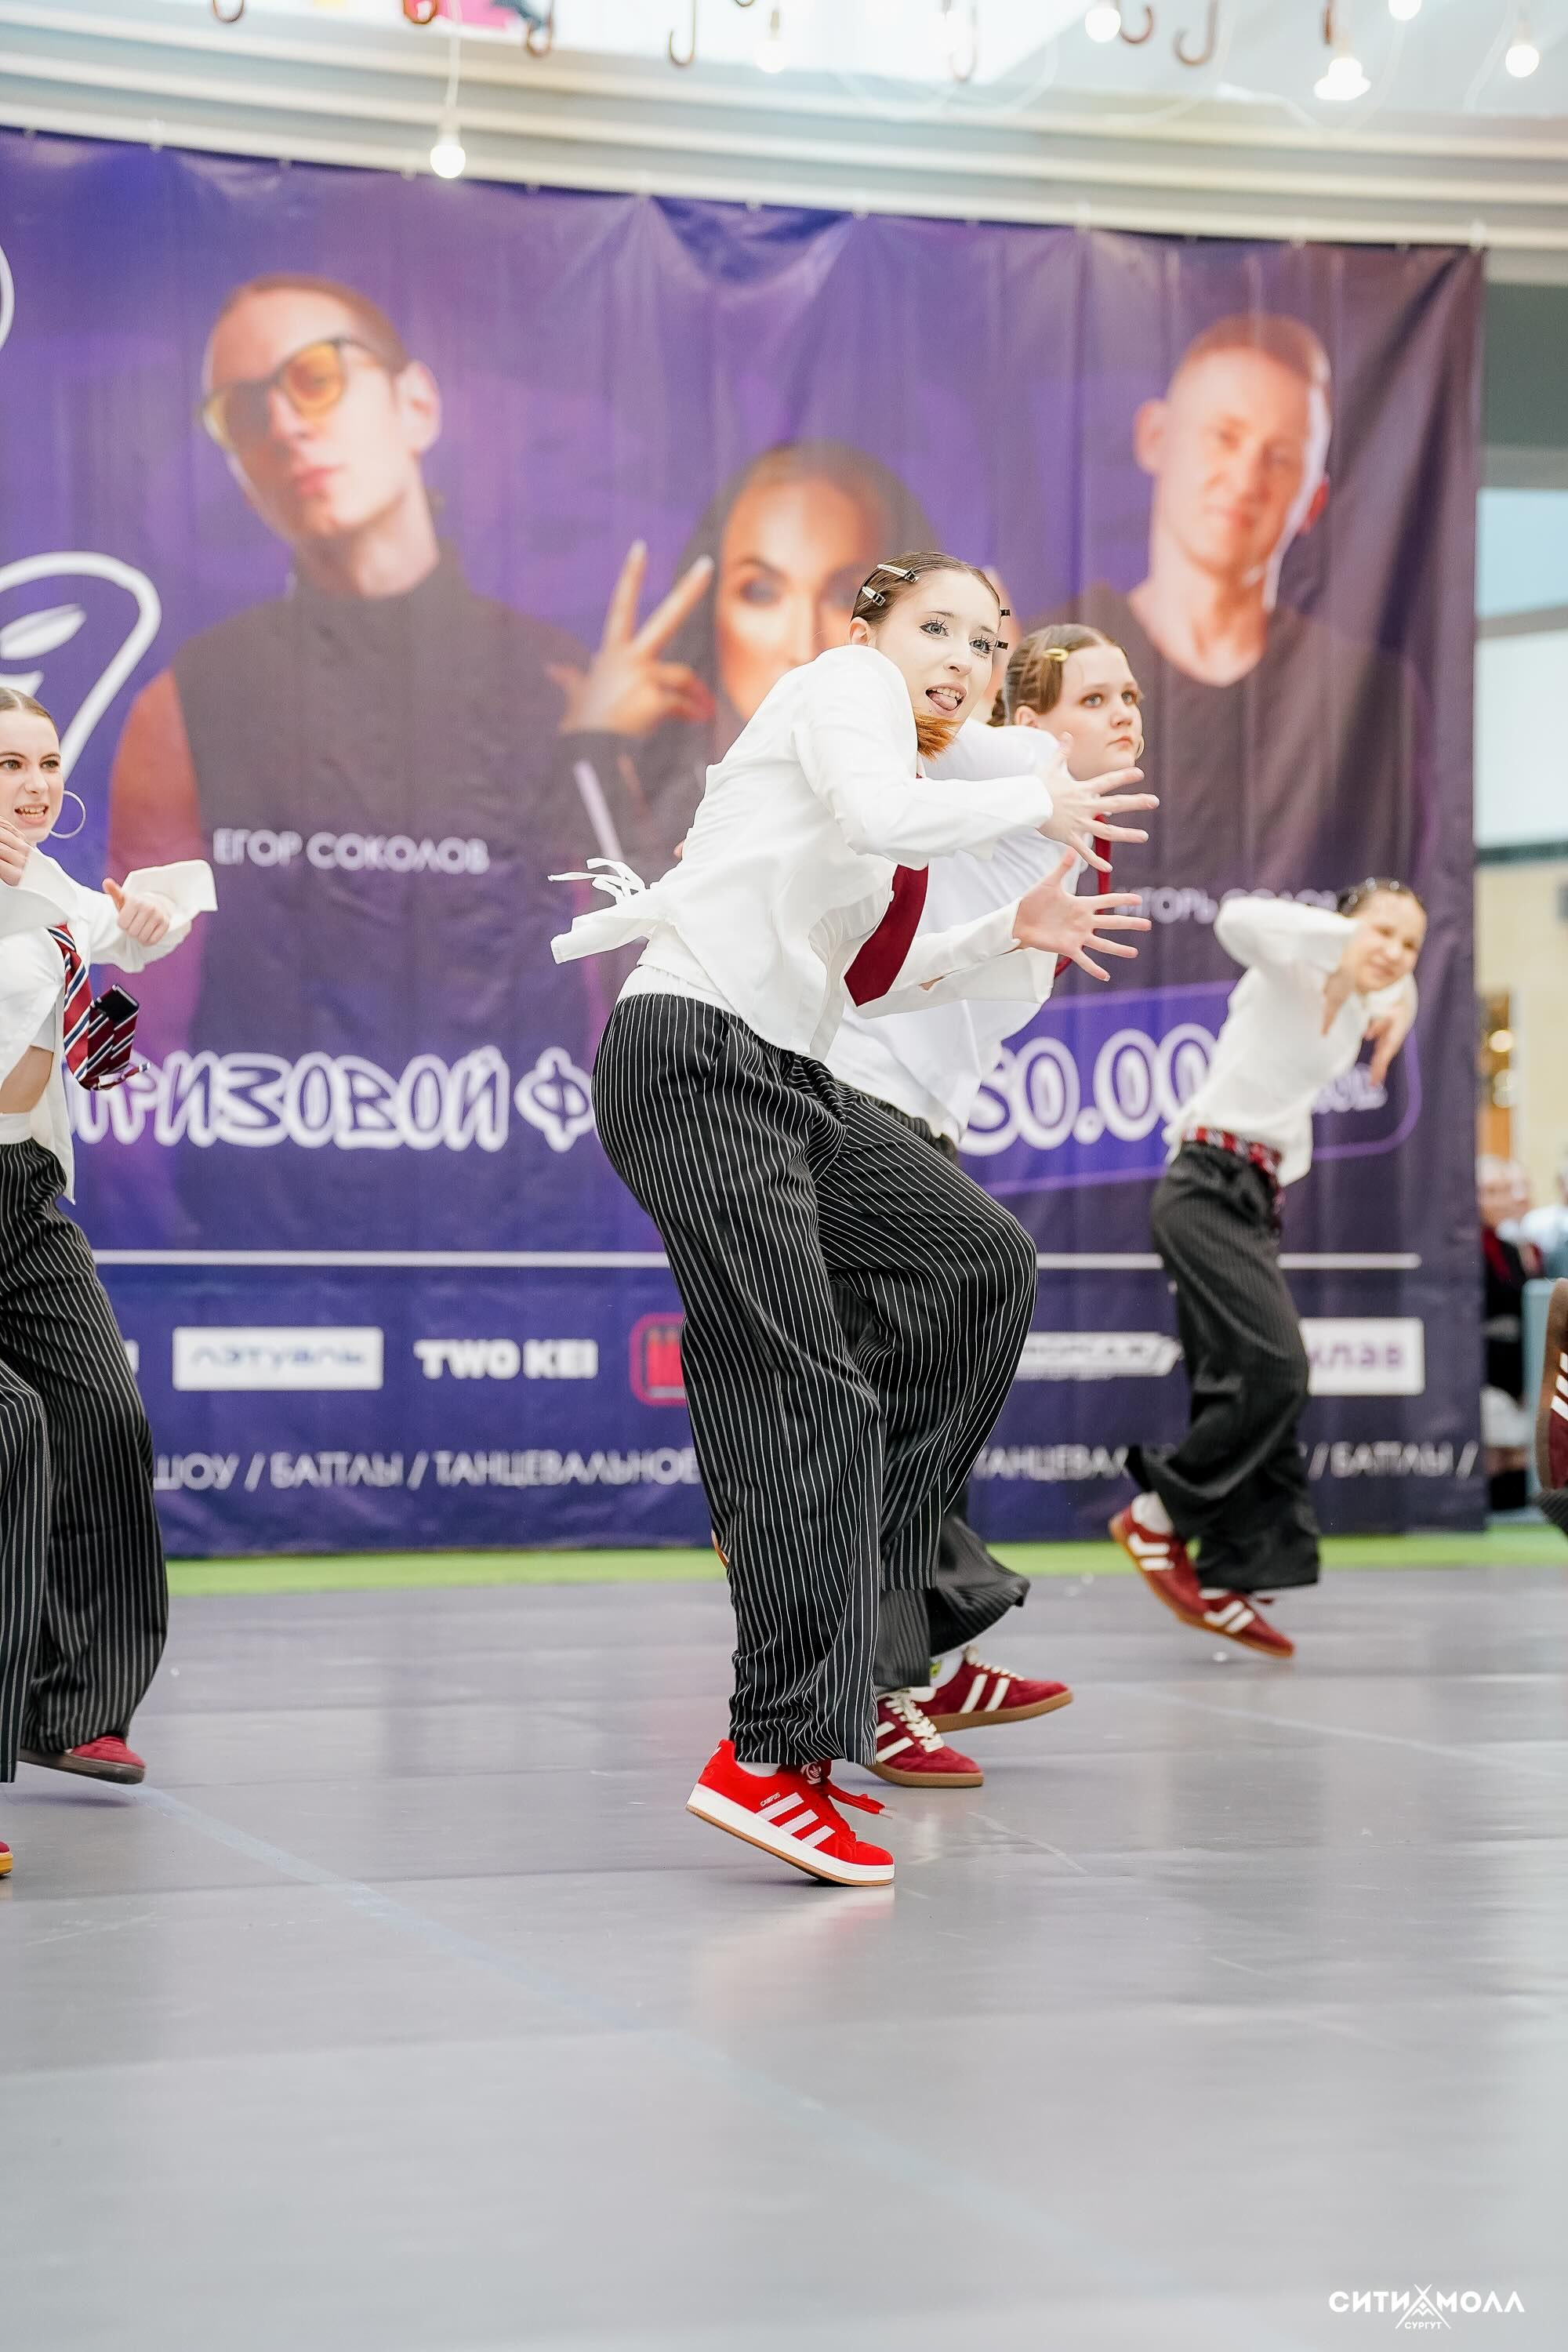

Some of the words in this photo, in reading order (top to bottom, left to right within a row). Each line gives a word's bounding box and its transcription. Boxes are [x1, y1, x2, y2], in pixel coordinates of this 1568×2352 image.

[213, 827, 303, 867] ЕГОР
[306, 831, 490, 875] СОКОЛОВ
[413, 1338, 521, 1380] TWO
[270, 1450, 405, 1490] БАТТЛЫ
[1330, 1441, 1454, 1478] БАТТЛЫ
